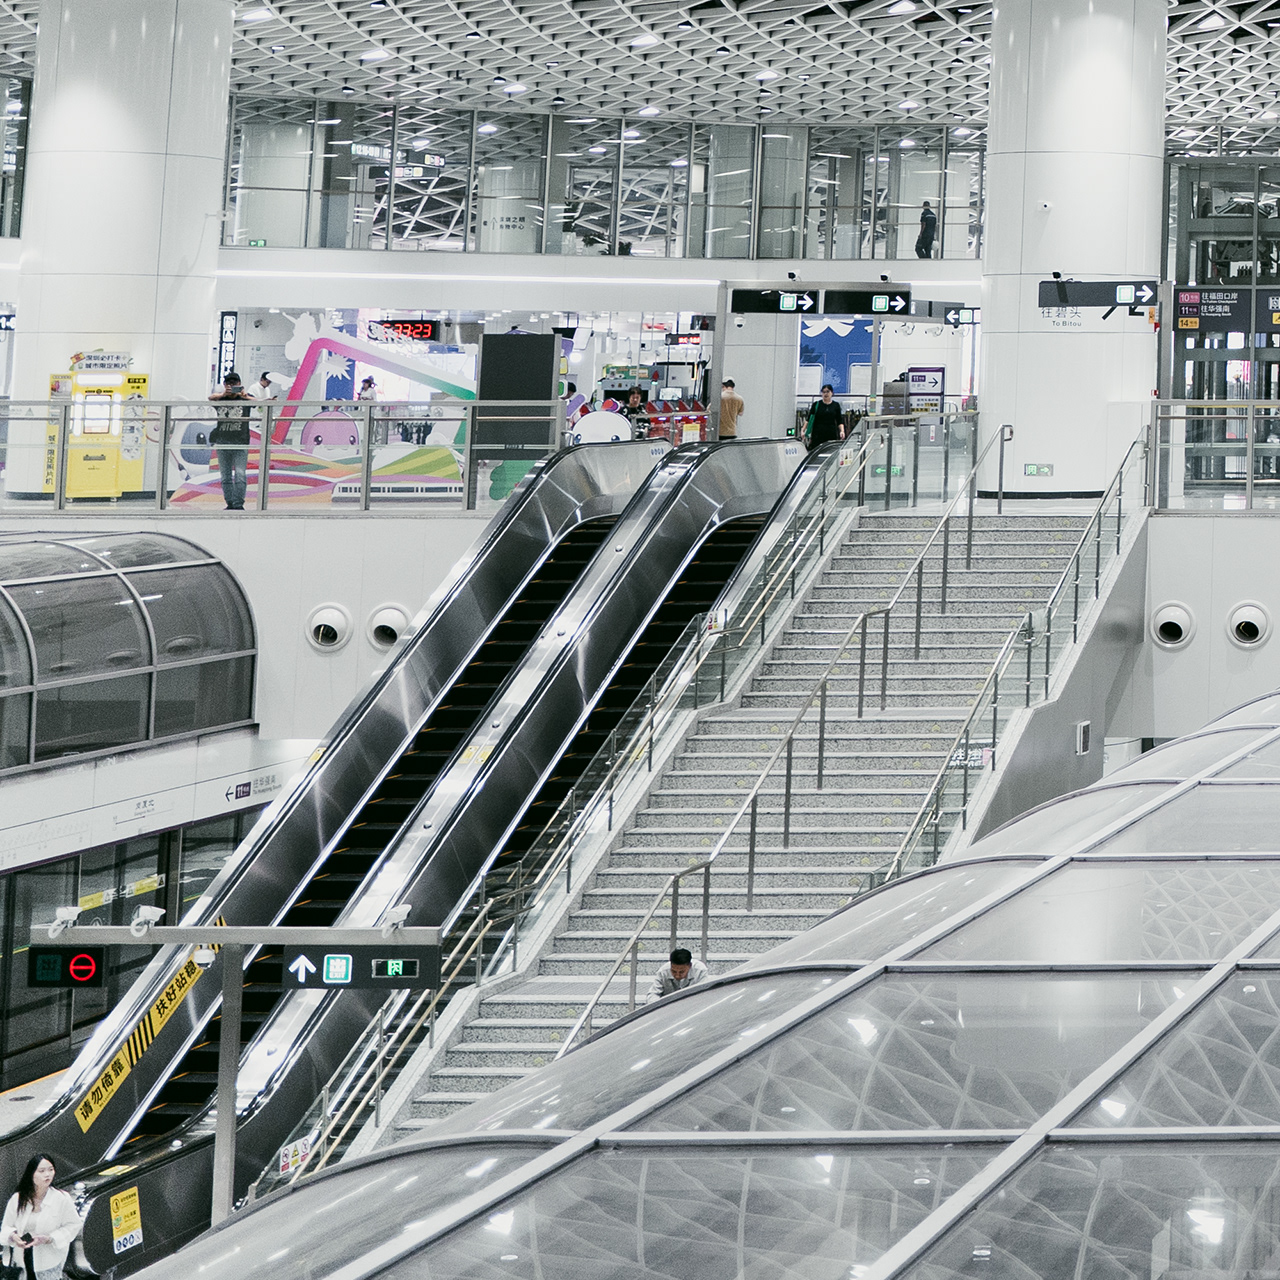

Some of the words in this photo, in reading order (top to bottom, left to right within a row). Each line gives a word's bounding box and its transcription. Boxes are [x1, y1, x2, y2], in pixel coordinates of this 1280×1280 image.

[1180, 293, 1190, 302] 10
[1181, 306, 1189, 314] 11
[156, 960, 197, 1018] 扶好站稳
[79, 1058, 125, 1121] 请勿倚靠
